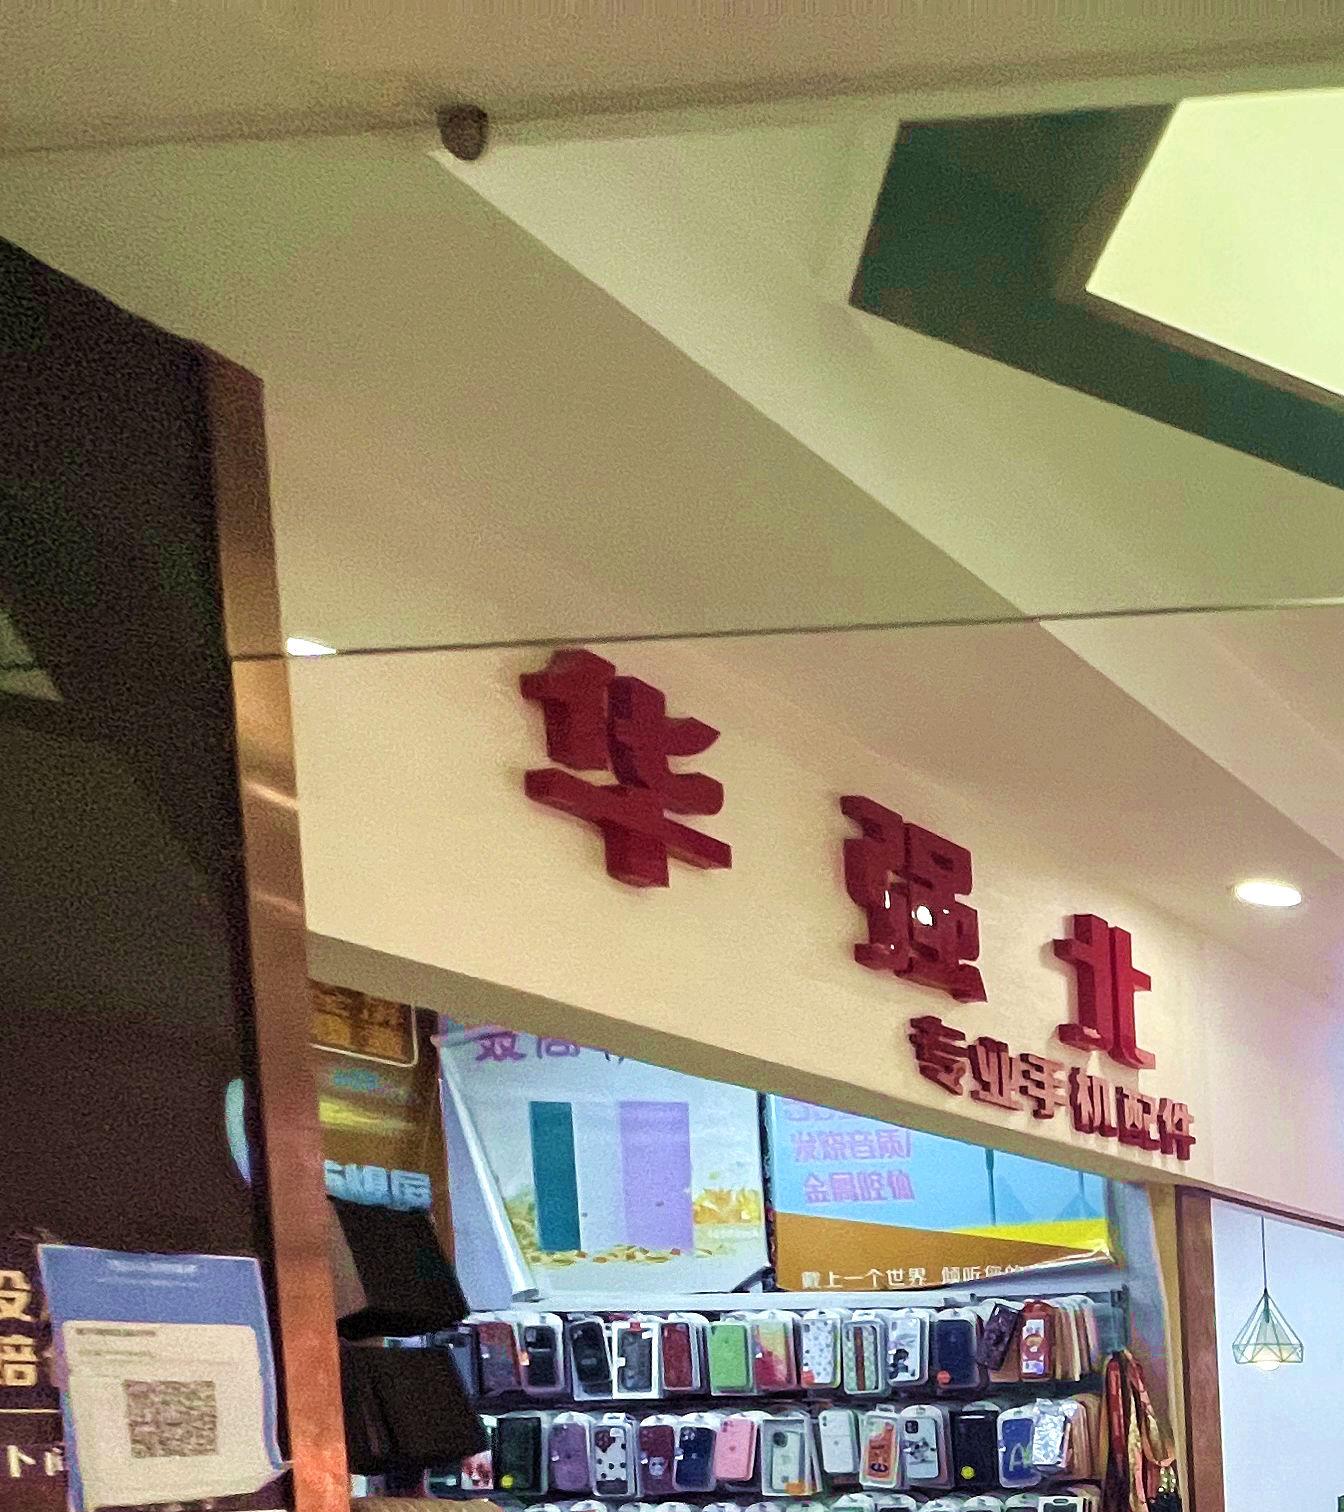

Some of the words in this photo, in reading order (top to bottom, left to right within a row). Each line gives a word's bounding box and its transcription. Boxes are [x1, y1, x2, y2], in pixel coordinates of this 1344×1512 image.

[520, 648, 1156, 1070] 华强北
[908, 1015, 1197, 1161] 专业手机配件
